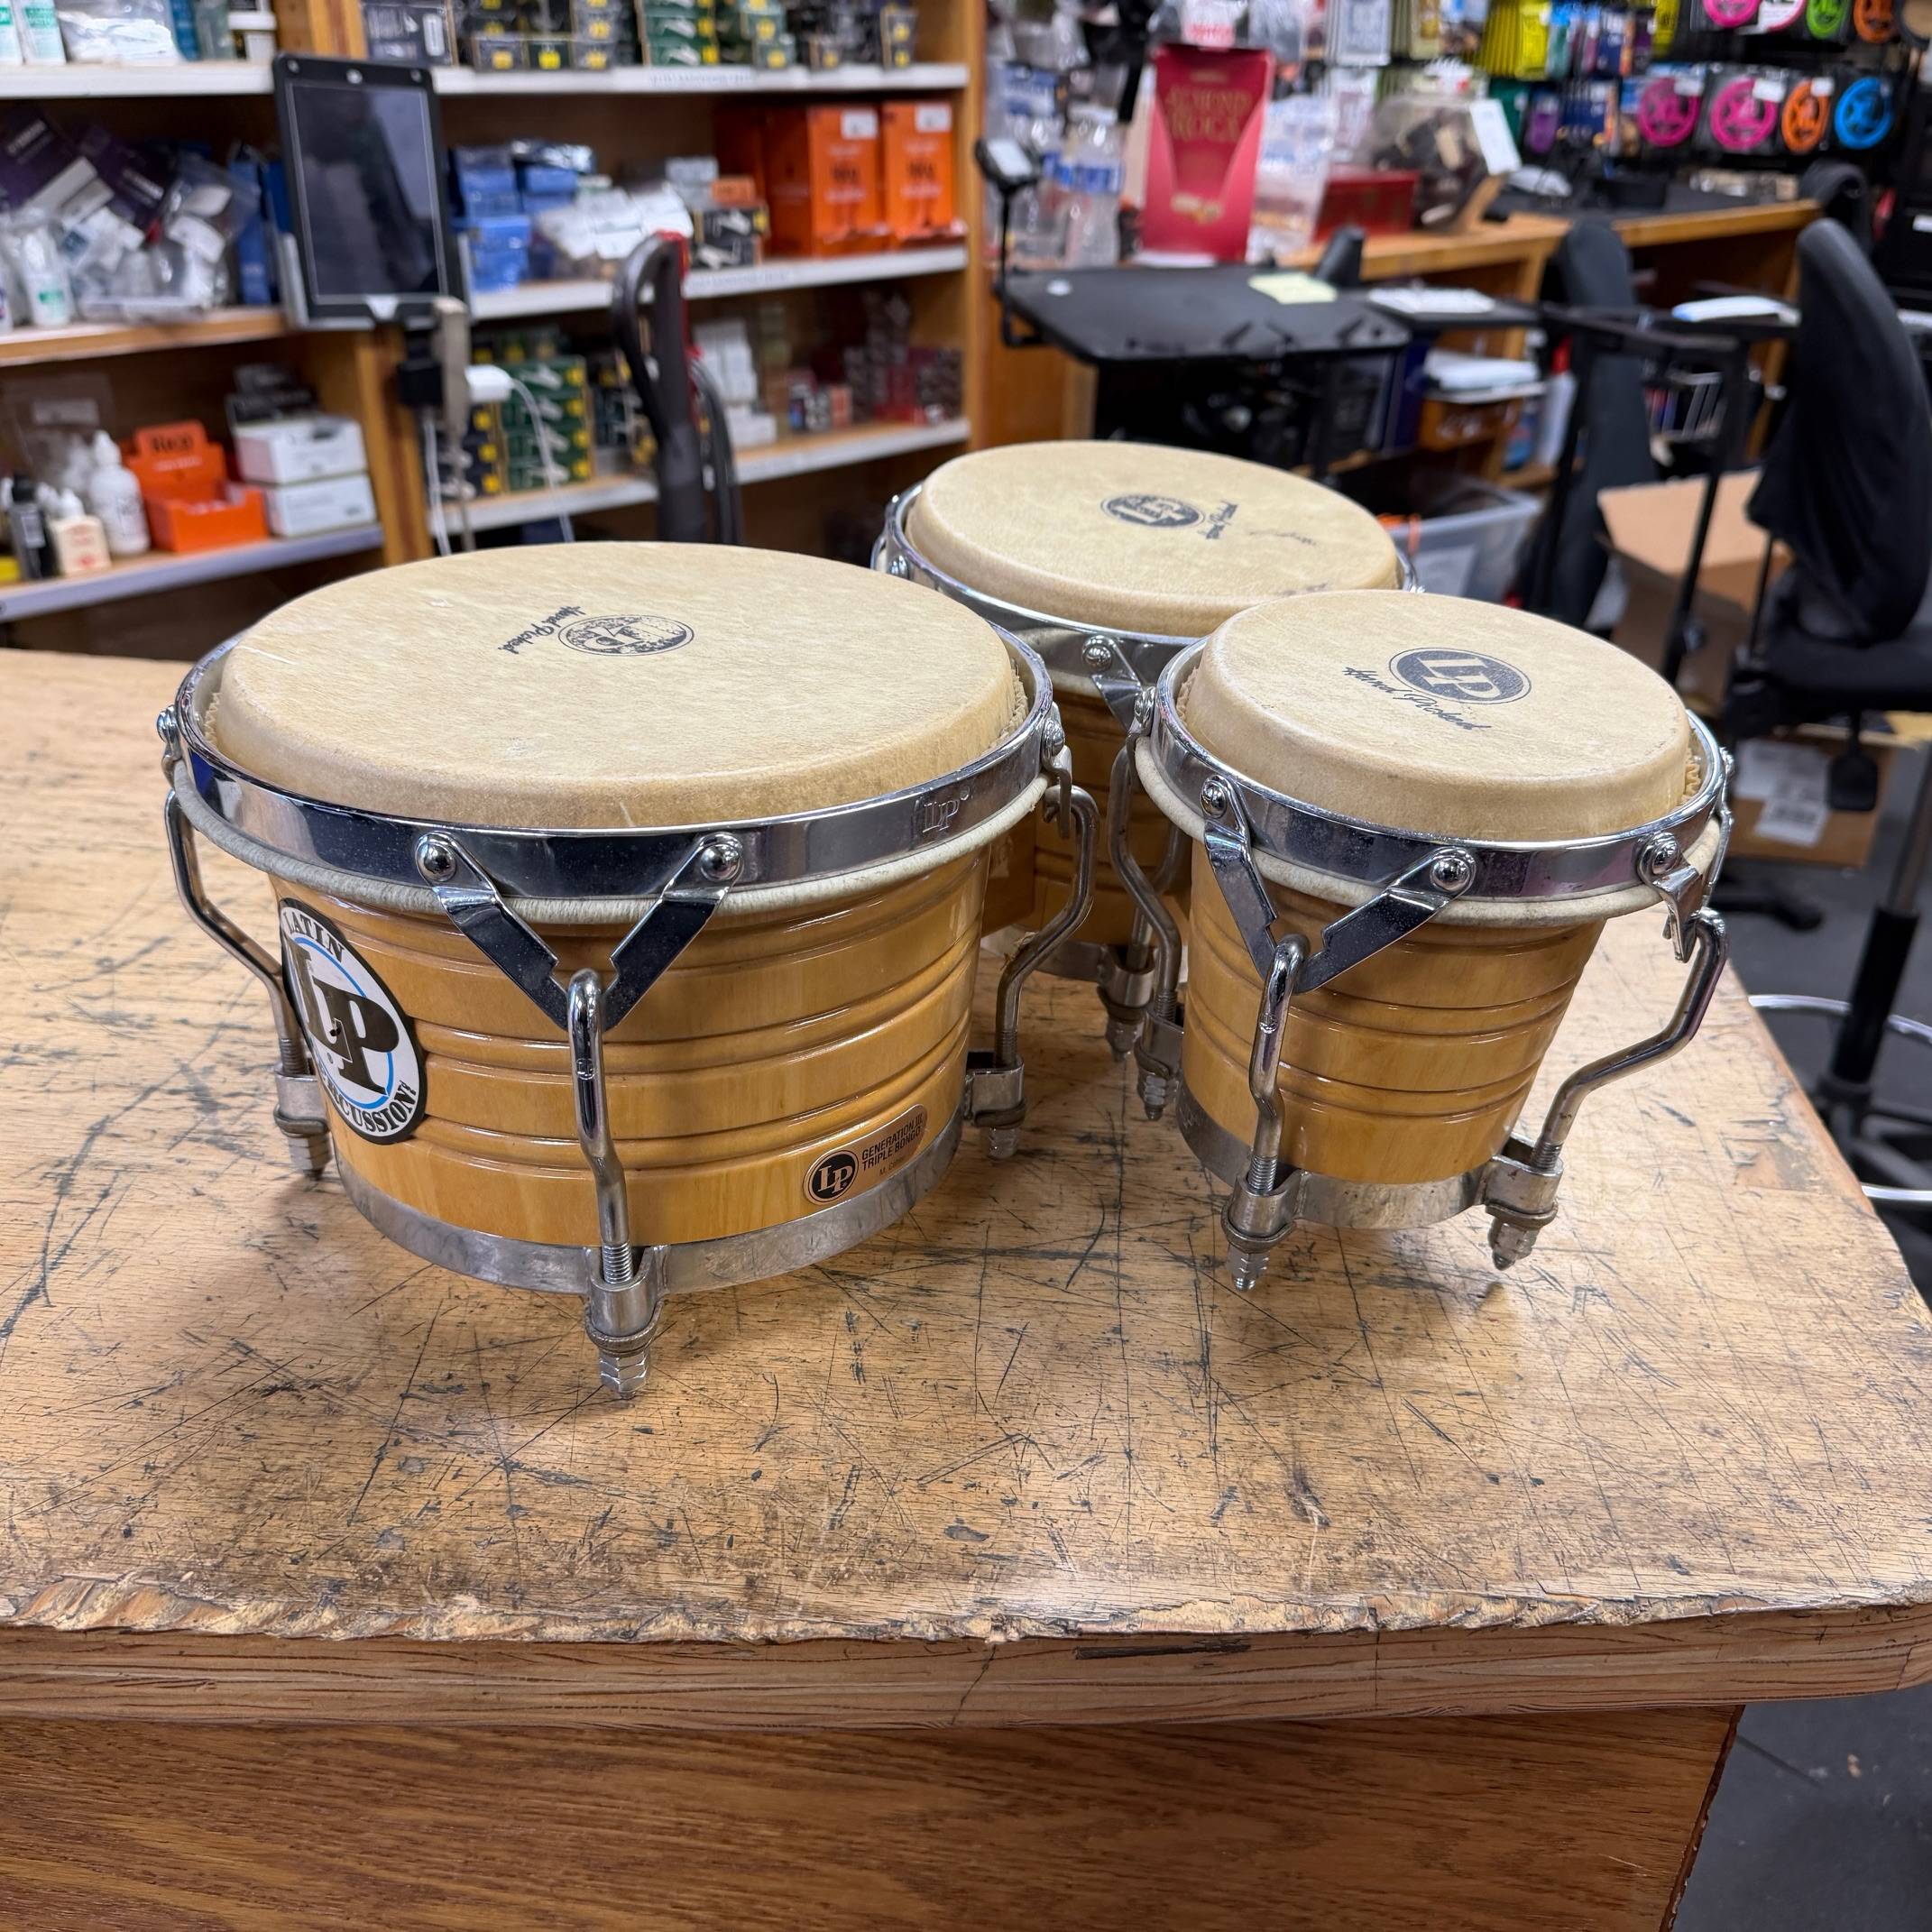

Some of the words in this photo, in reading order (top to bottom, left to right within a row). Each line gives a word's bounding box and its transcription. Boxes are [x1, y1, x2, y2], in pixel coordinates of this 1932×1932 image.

[1412, 656, 1504, 700] LP
[922, 797, 961, 833] LP
[282, 911, 345, 963] LATIN
[282, 930, 400, 1096] LP
[861, 1119, 915, 1162] GENERATION
[862, 1148, 893, 1172] TRIPLE
[894, 1126, 921, 1154] BONGO
[817, 1164, 853, 1194] LP
